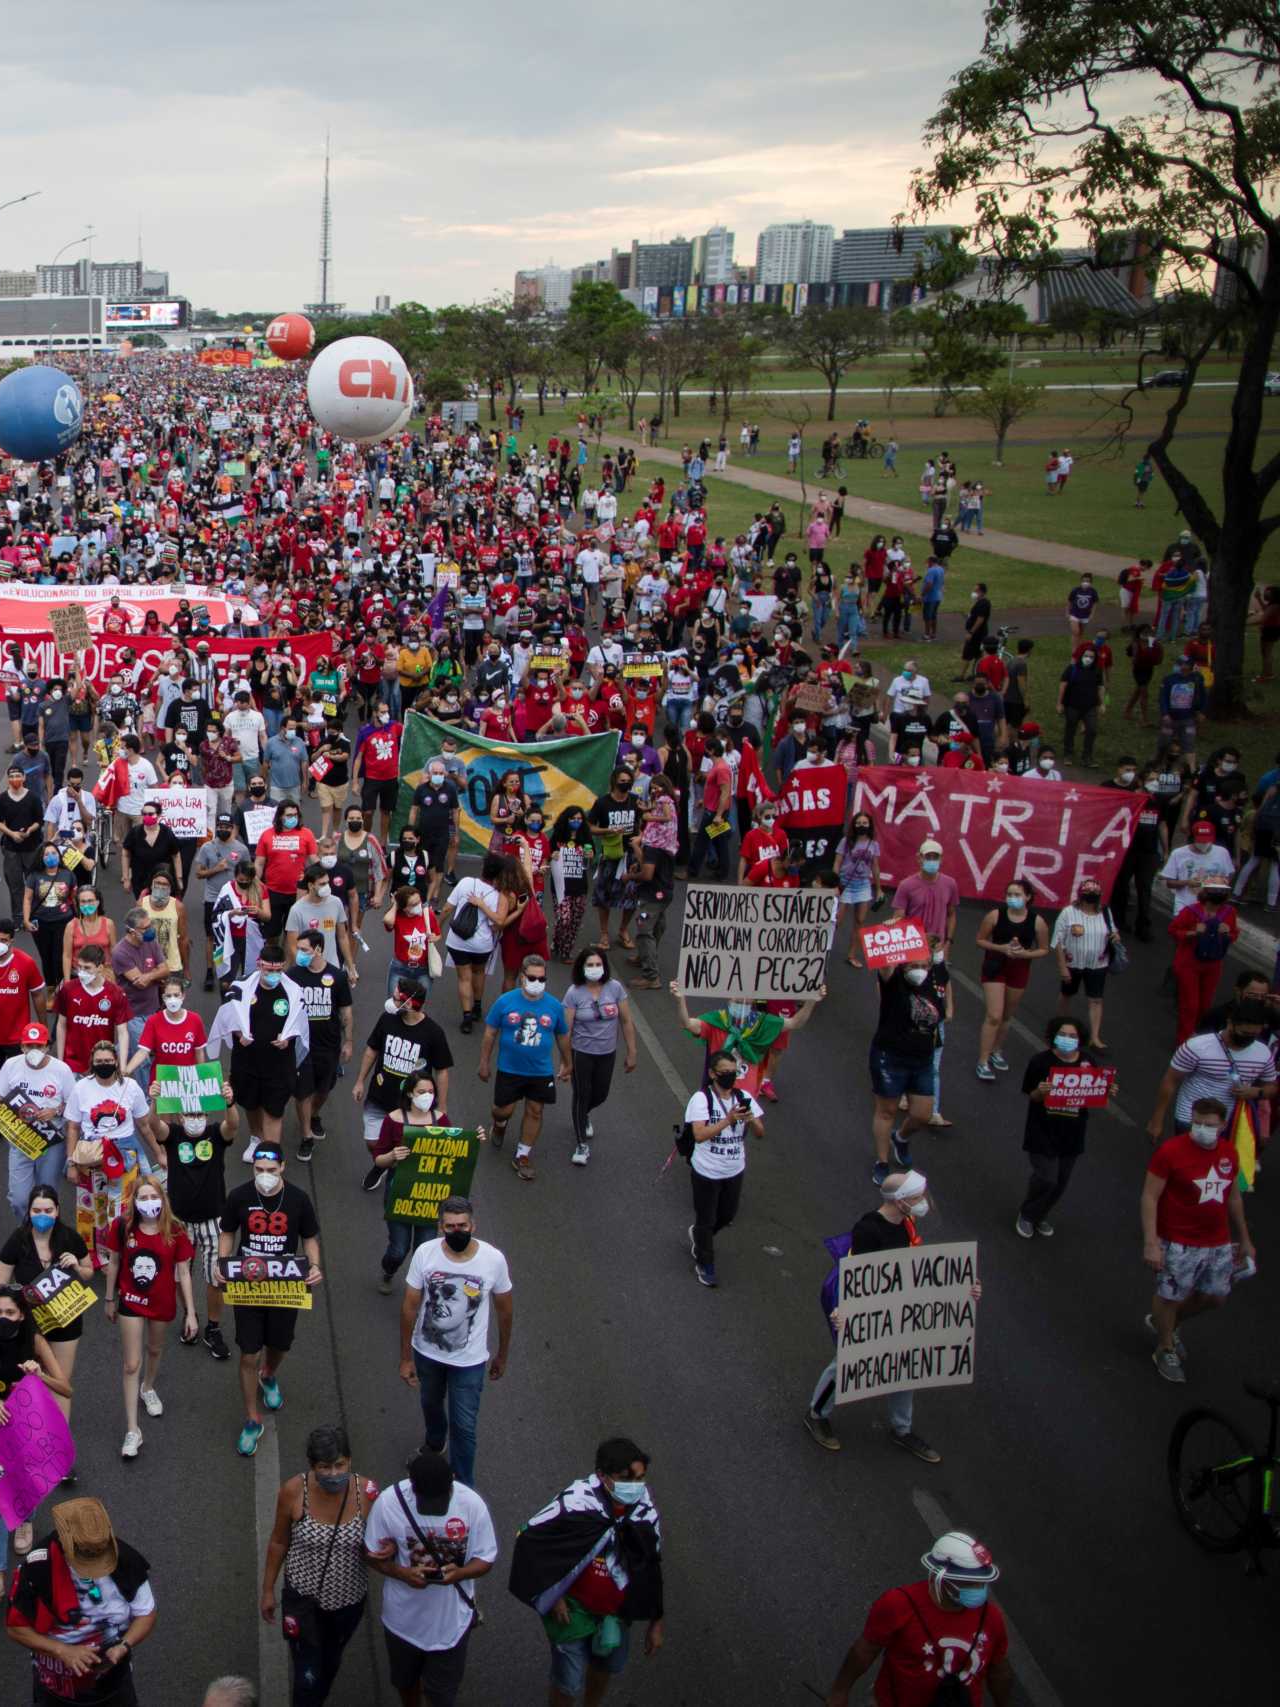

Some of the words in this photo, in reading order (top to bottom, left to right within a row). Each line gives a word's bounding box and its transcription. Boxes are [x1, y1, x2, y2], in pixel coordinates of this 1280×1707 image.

[686, 890, 760, 923] SERVIDORES
[763, 890, 833, 924] ESTÁVEIS
[683, 923, 752, 952] DENUNCIAM
[758, 926, 828, 956] CORRUPÇÃO
[863, 925, 920, 949] FORA
[867, 937, 924, 958] BOLSONARO
[685, 952, 720, 988] NÃO
[727, 956, 743, 992] À
[73, 1014, 109, 1027] crefisa
[161, 1042, 192, 1054] CCCP
[385, 1034, 421, 1062] FORA
[1052, 1073, 1108, 1088] FORA
[1049, 1087, 1107, 1097] BOLSONARO
[412, 1137, 469, 1158] AMAZÔNIA
[710, 1146, 725, 1155] ELE
[418, 1156, 436, 1174] EM
[439, 1154, 457, 1175] PÉ
[410, 1182, 451, 1200] ABAIXO
[1204, 1178, 1227, 1199] PT
[393, 1199, 439, 1219] BOLSON
[247, 1210, 289, 1236] 68
[249, 1234, 287, 1244] sempre
[250, 1242, 261, 1251] na
[264, 1243, 284, 1252] luta
[226, 1281, 307, 1294] BOLSONARO
[843, 1262, 902, 1300] RECUSA
[911, 1256, 974, 1288] VACINA
[841, 1309, 893, 1348] ACEITA
[900, 1301, 974, 1334] PROPINA
[841, 1345, 946, 1393] IMPEACHMENT
[948, 1336, 972, 1376] JÁ
